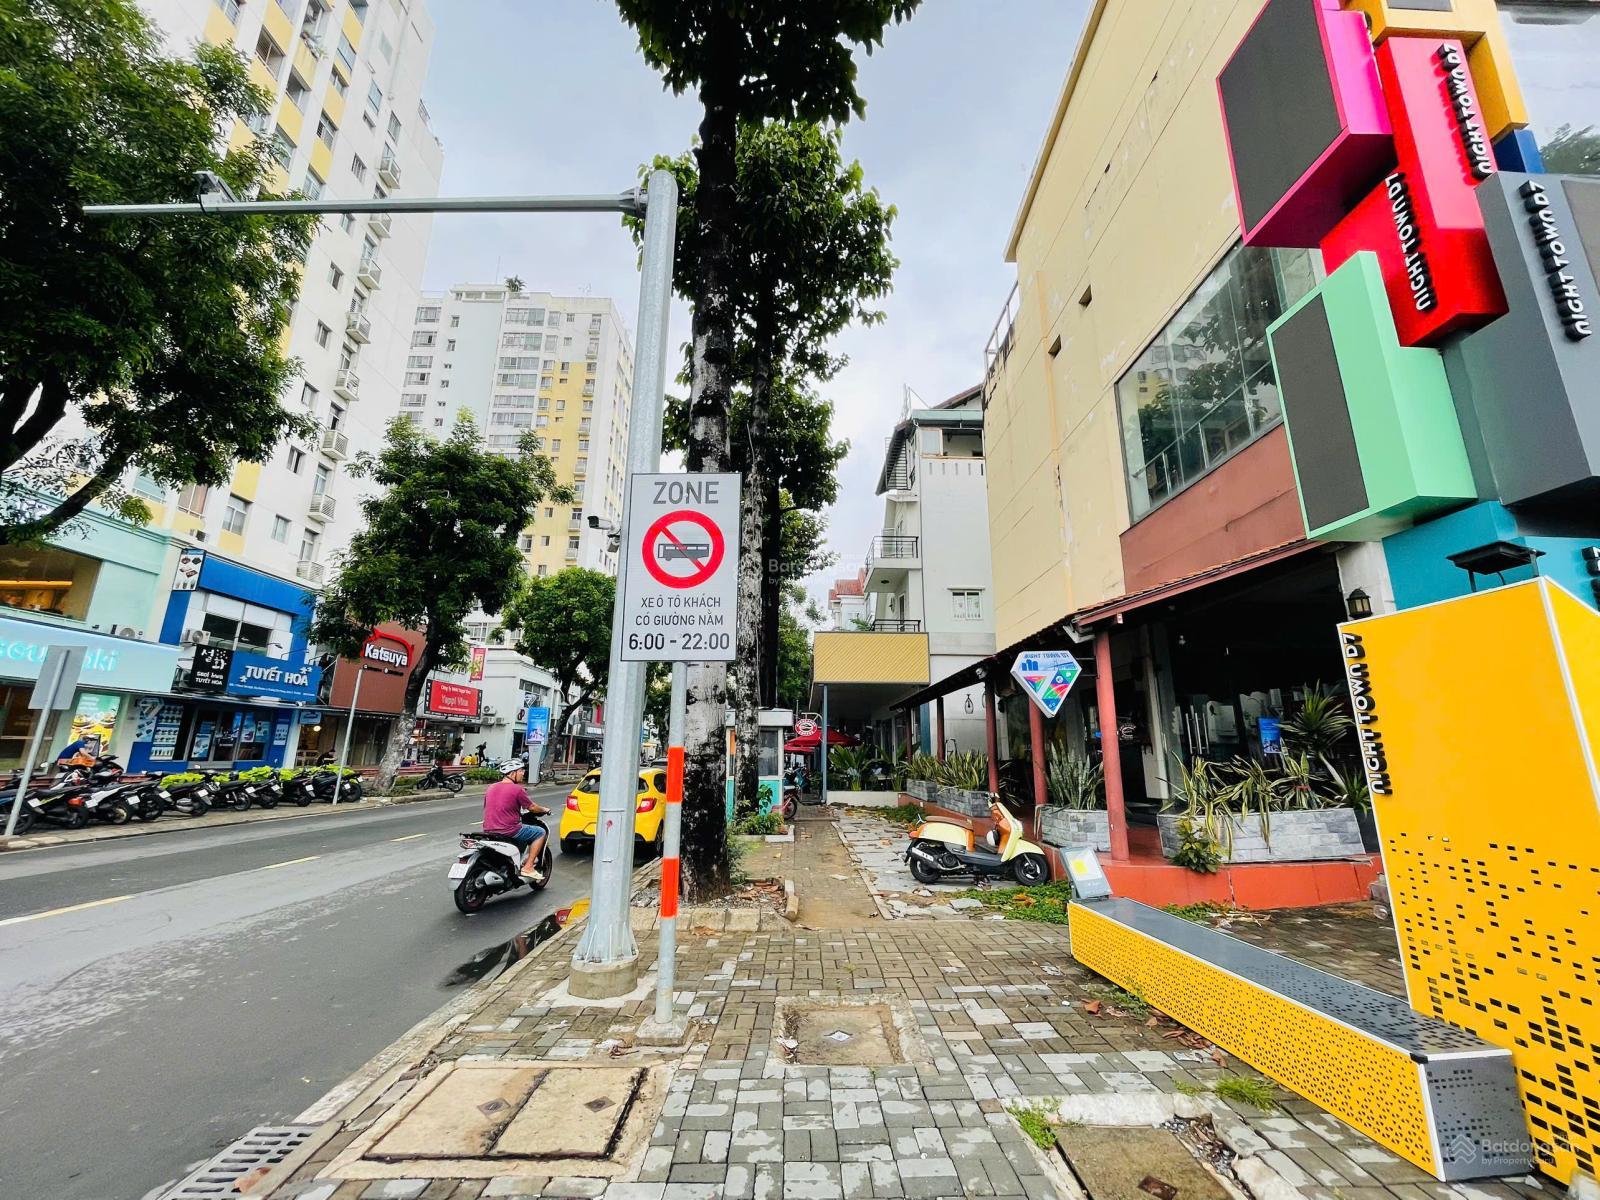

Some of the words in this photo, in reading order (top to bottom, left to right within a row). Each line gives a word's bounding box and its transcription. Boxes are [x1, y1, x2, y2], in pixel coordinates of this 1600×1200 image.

[652, 480, 720, 505] ZONE
[641, 596, 656, 608] XE
[667, 594, 681, 608] TÔ
[683, 592, 721, 608] KHÁCH
[635, 610, 650, 626] CÓ
[628, 632, 665, 651] 6:00
[681, 632, 730, 651] 22:00
[364, 643, 408, 668] Katsuya
[245, 665, 283, 682] TUYẾT
[284, 672, 309, 686] HOA
